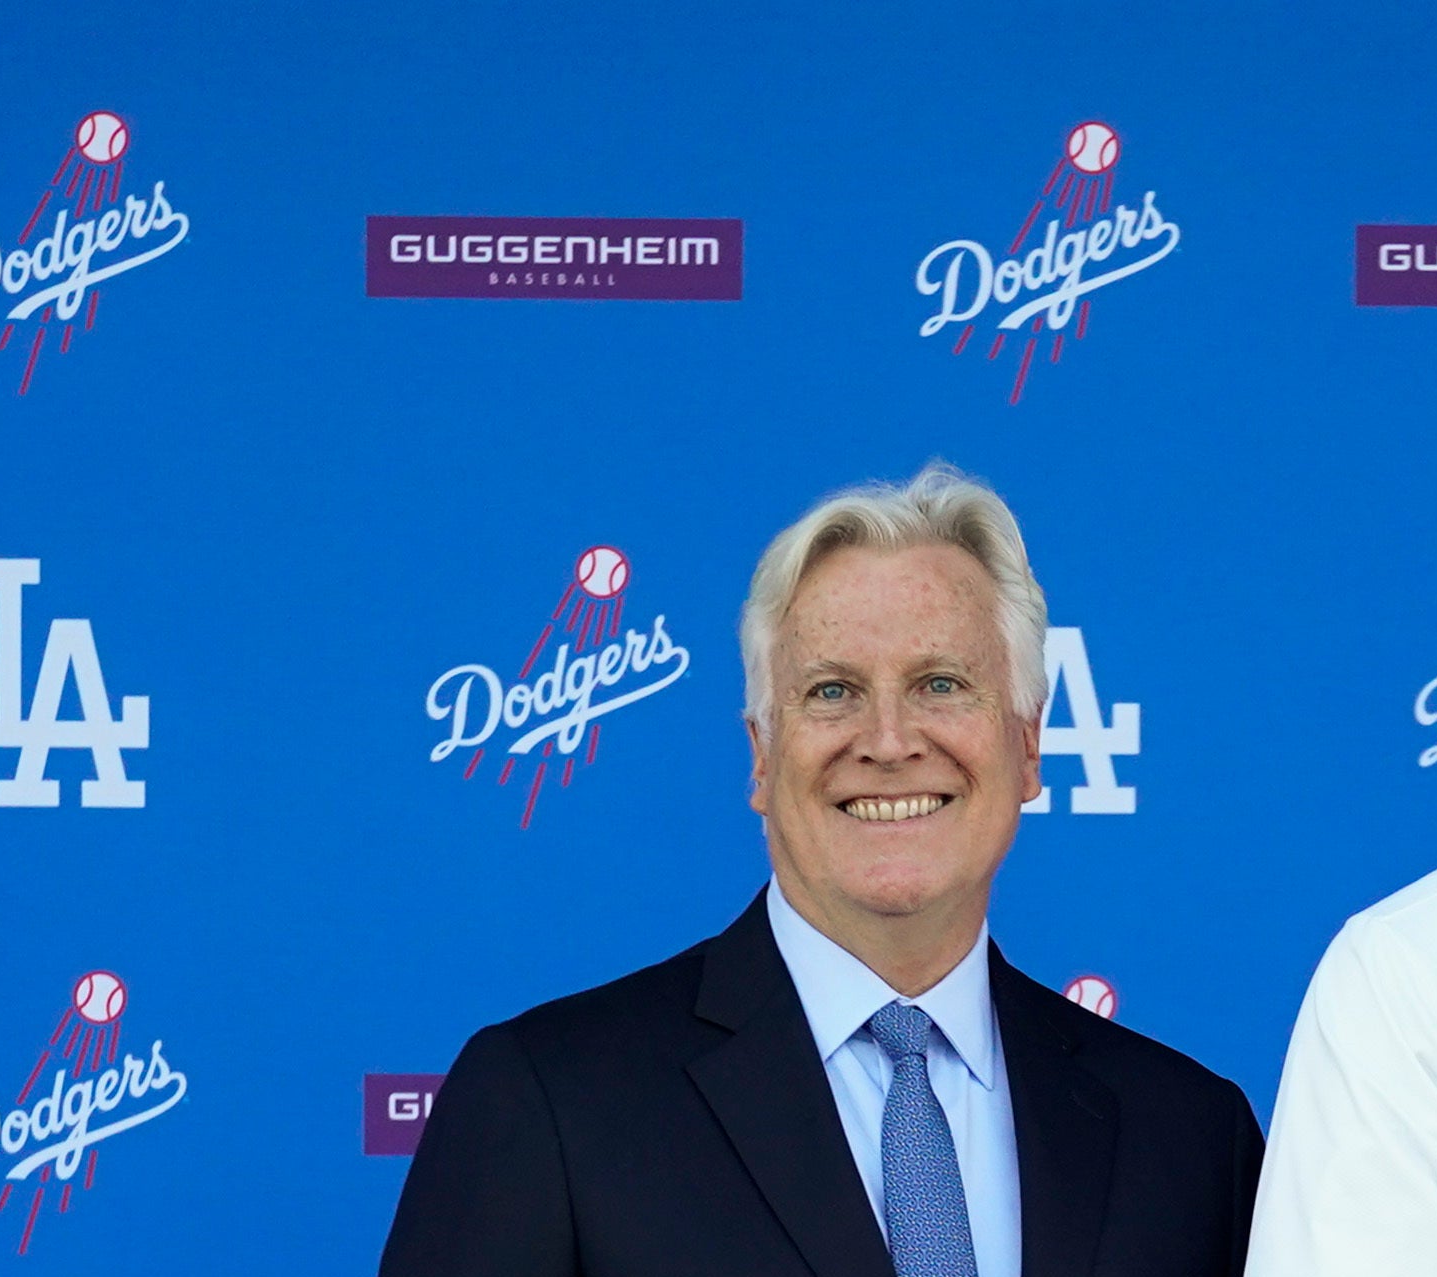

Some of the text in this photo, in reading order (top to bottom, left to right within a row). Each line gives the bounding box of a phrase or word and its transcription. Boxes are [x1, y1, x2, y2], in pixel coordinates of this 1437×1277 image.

[390, 234, 719, 265] GUGGENHEIM
[489, 271, 615, 286] BASEBALL
[915, 190, 1180, 337] Dodgers
[425, 614, 690, 763] Dodgers
